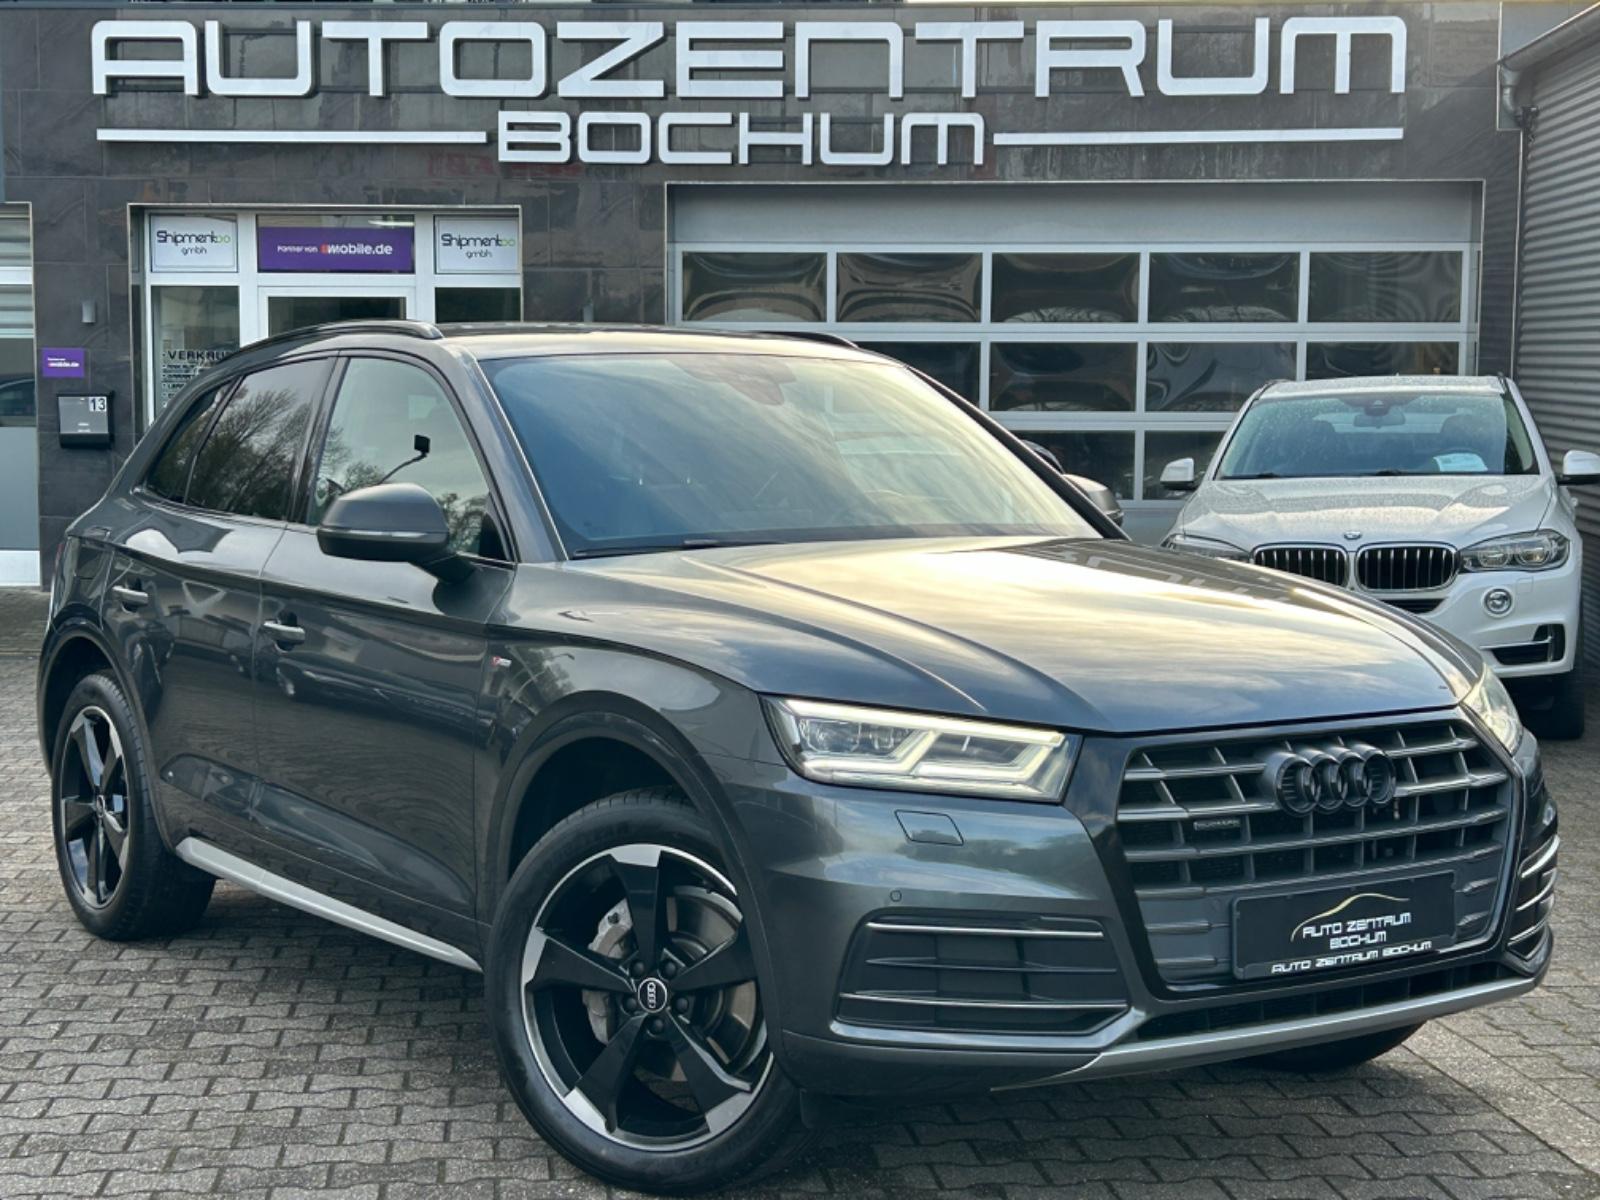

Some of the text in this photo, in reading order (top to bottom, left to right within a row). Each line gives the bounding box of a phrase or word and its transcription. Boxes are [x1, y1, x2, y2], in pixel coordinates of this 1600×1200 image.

[91, 15, 1408, 99] AUTOZENTRUM
[498, 111, 985, 165] BOCHUM
[325, 242, 393, 255] mobile.de
[167, 350, 228, 361] VERKAU
[90, 398, 106, 411] 13
[1302, 912, 1411, 939] AUTO ZENTRUM
[1329, 930, 1387, 950] BOCHUM
[1271, 940, 1432, 974] AUTO ZENTRUM BOCHUM
